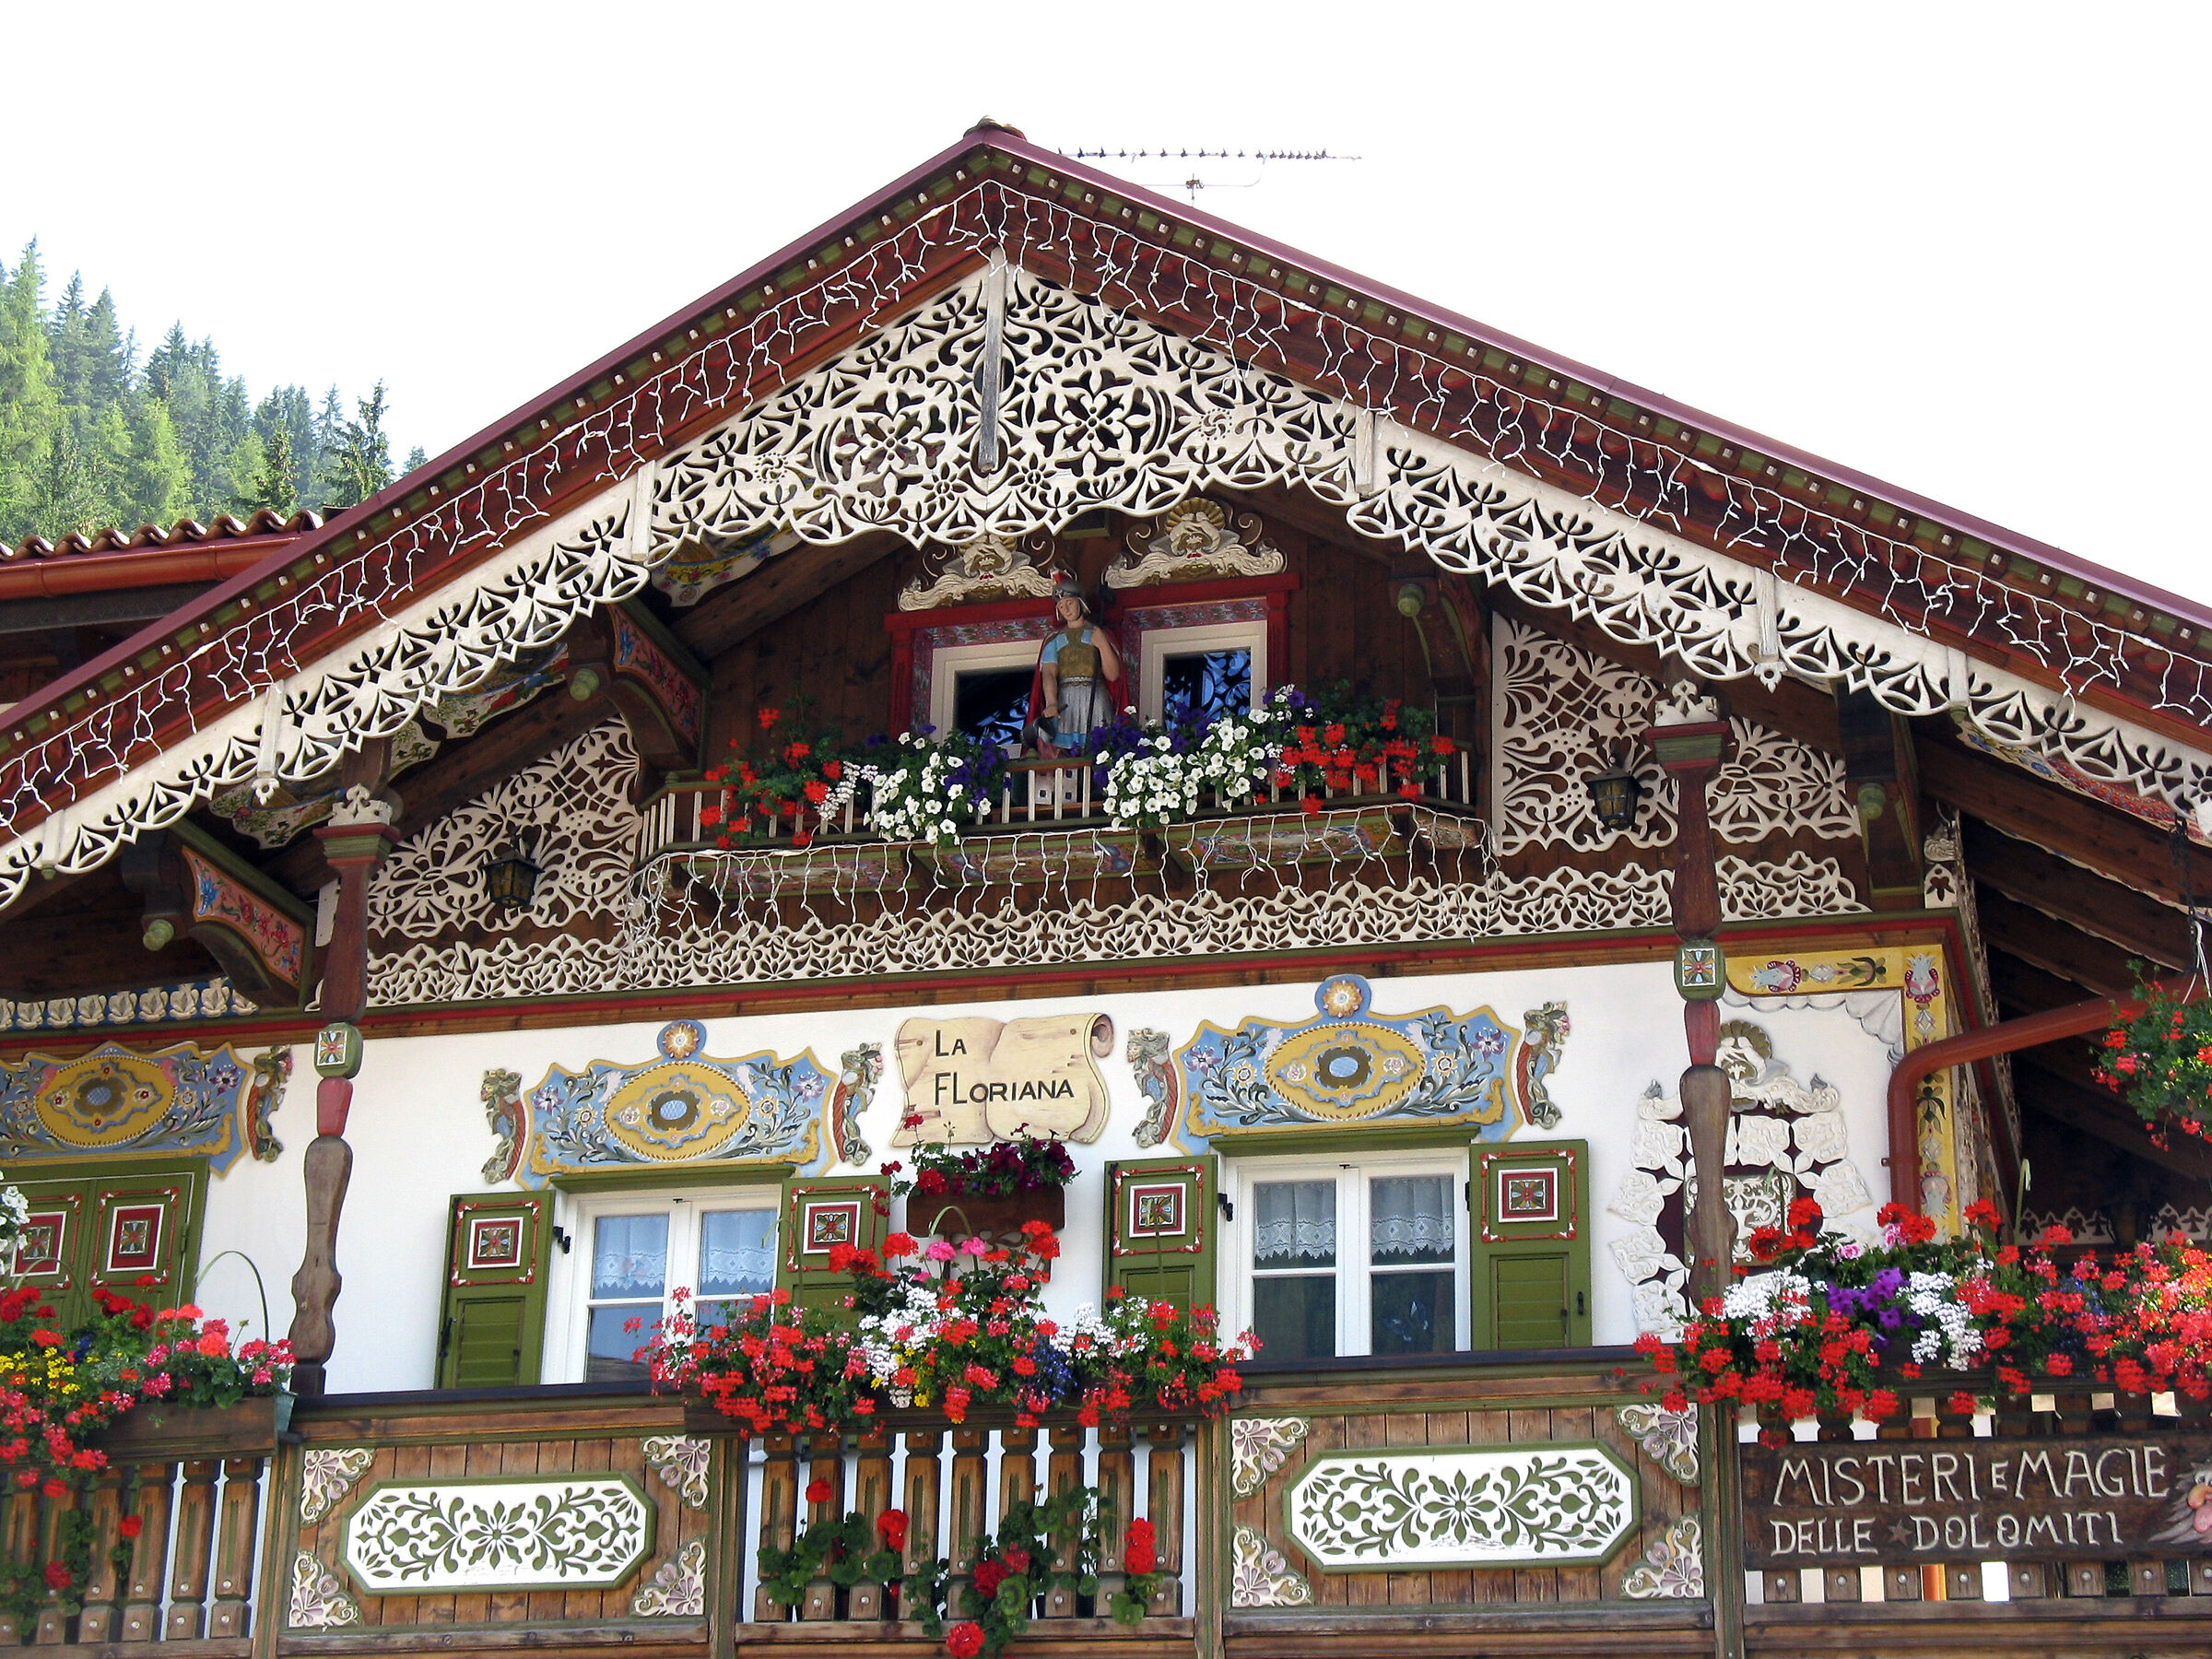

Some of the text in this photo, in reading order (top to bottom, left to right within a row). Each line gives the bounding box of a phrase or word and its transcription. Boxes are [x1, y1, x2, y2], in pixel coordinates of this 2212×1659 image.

[935, 1030, 967, 1057] LA
[935, 1072, 1074, 1105] FLORIANA
[1773, 1446, 2169, 1506] MISTERI E MAGIE
[1770, 1512, 2124, 1556] DELLE DOLOMITI
